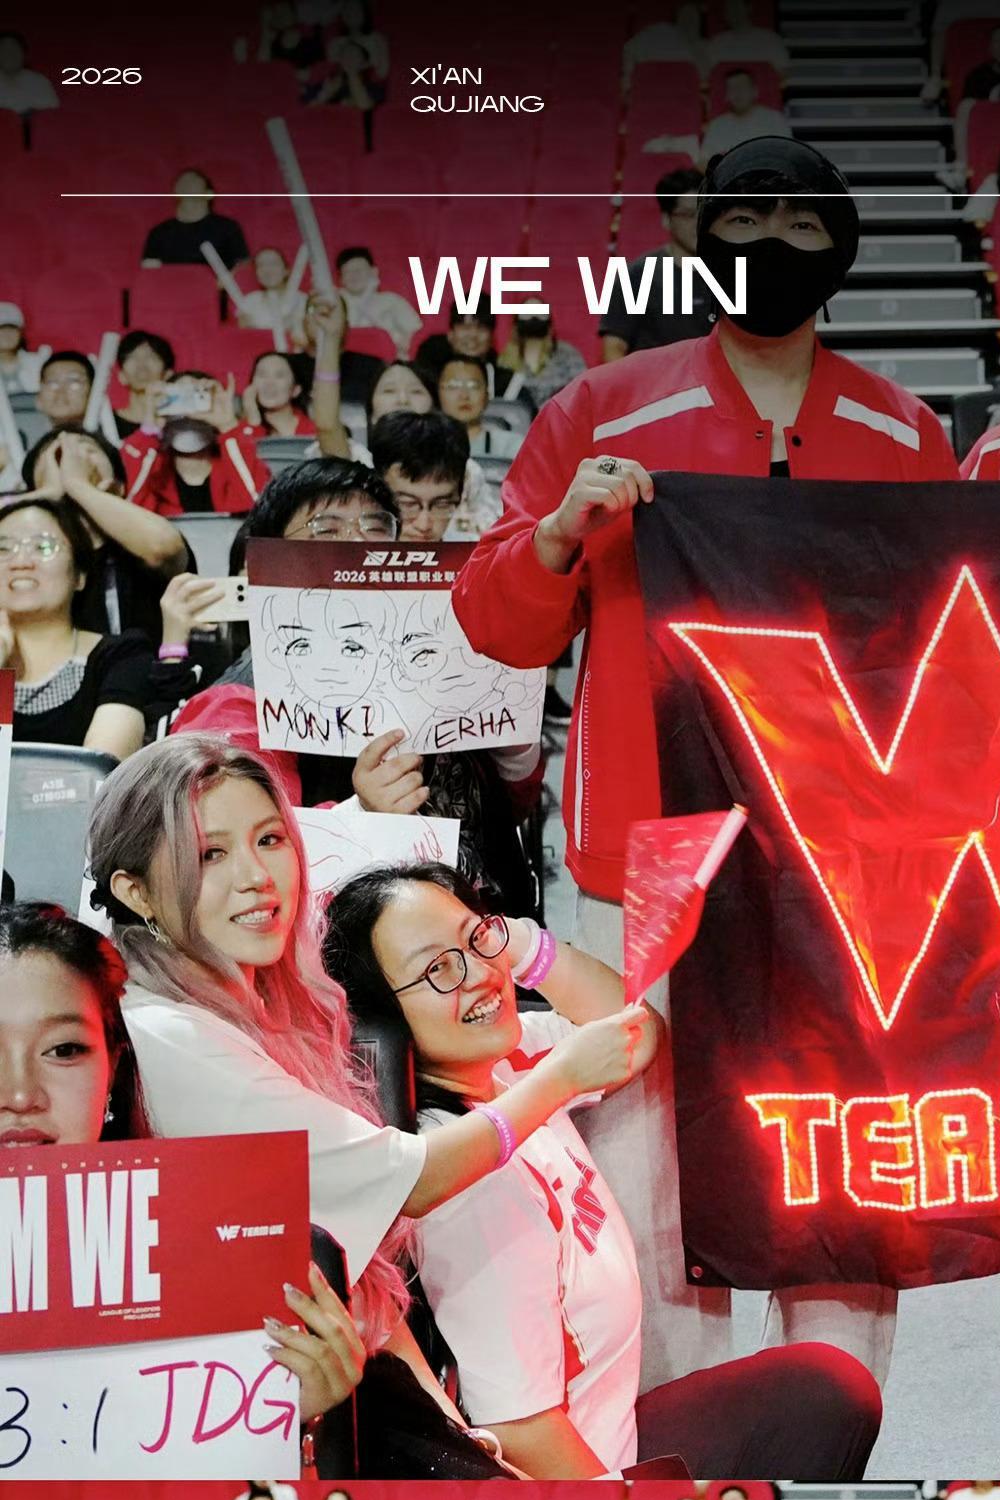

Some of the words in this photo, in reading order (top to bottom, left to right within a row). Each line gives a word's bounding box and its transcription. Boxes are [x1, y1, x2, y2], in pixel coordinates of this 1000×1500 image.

[333, 570, 367, 583] 2026
[369, 570, 460, 583] 英雄联盟职业联
[387, 550, 440, 567] LPL
[262, 697, 375, 742] MONKI
[433, 706, 517, 749] ERHA
[65, 1168, 161, 1309] WE
[138, 1359, 297, 1454] JDG
